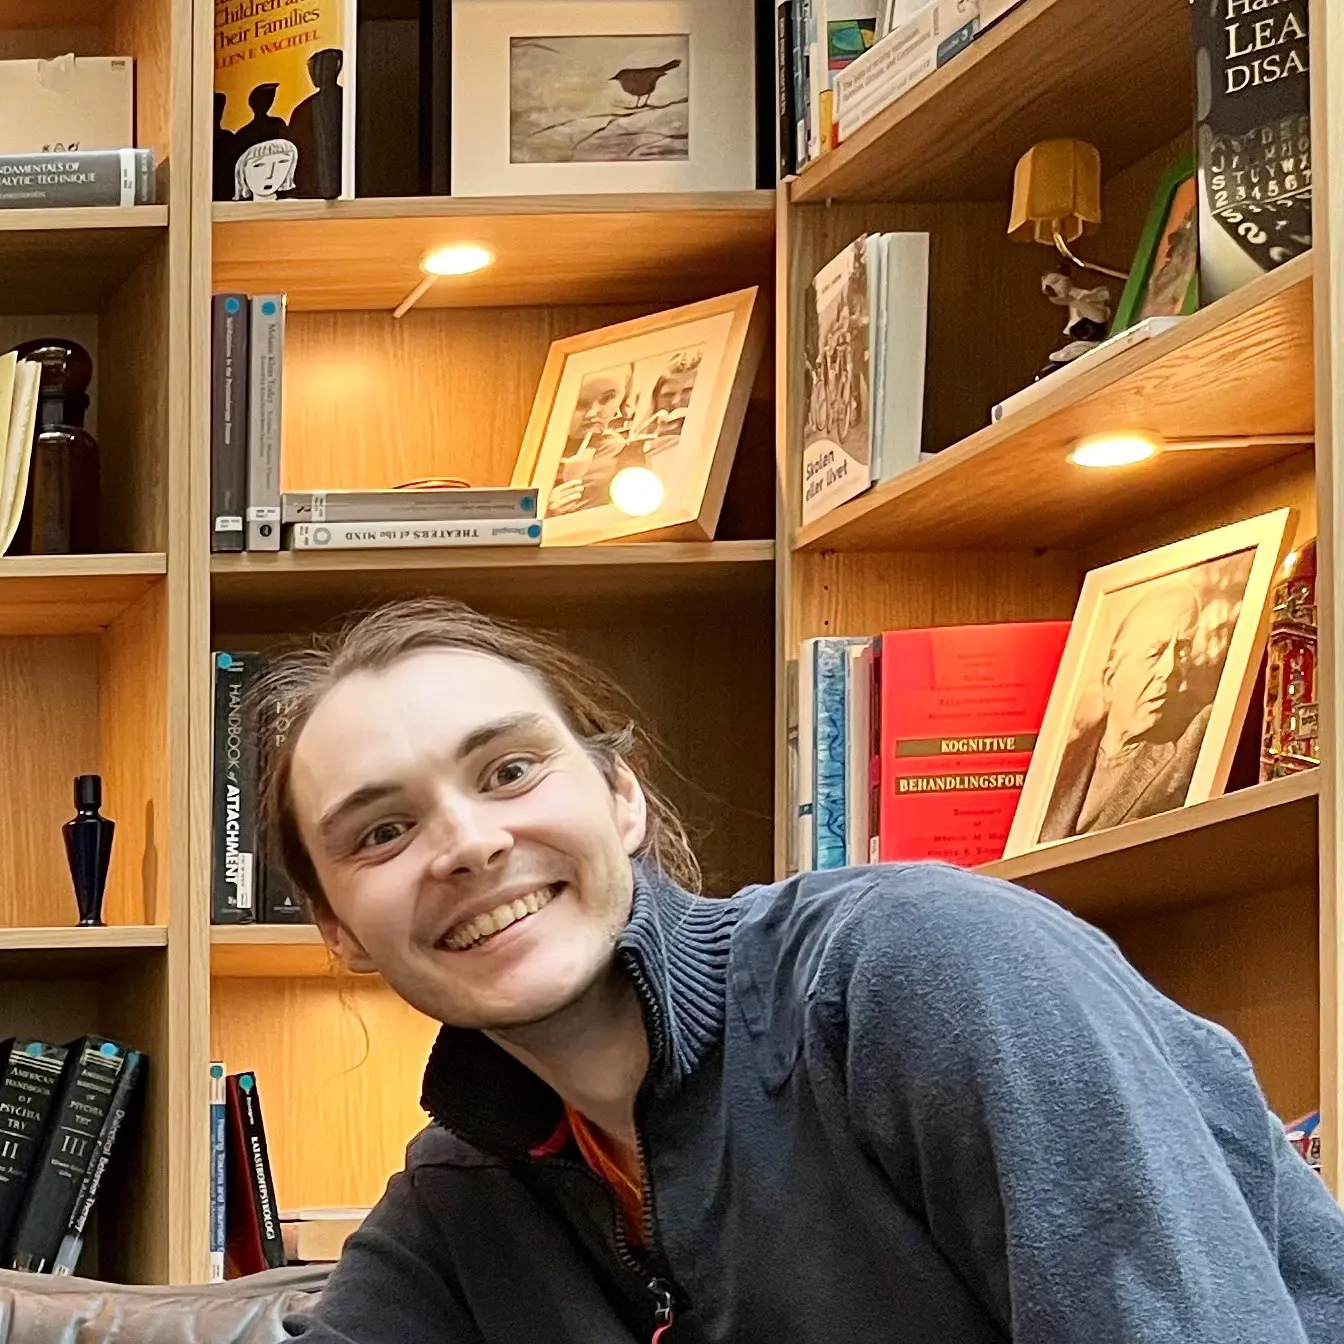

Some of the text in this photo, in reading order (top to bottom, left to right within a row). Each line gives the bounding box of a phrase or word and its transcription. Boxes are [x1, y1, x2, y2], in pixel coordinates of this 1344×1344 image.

[254, 7, 320, 38] Families
[66, 162, 80, 171] OF
[37, 173, 96, 185] TECHNIQUE
[413, 528, 479, 538] THEATERS
[227, 684, 241, 771] HANDBOOK
[941, 737, 1016, 753] KOGNITIVE
[899, 774, 1025, 793] BEHANDLINGSFOR
[225, 784, 240, 884] ATTACHMENT
[10, 1067, 55, 1084] AMERICAN
[7, 1118, 27, 1131] TRY
